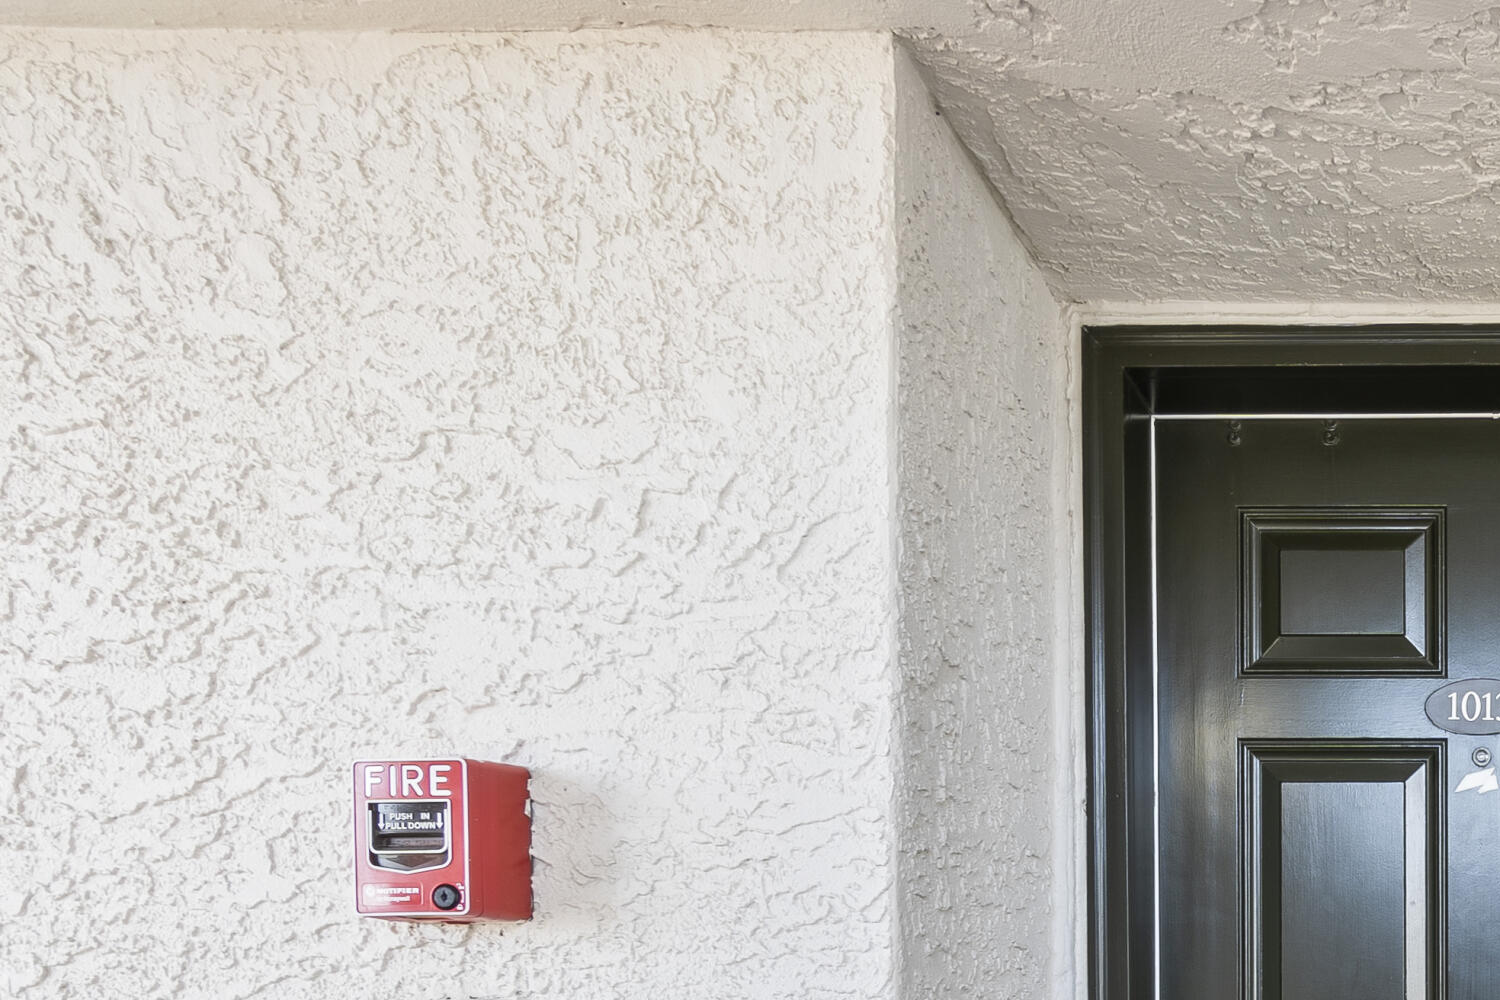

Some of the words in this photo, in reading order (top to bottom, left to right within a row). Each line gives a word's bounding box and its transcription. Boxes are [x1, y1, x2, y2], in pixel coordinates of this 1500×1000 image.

[364, 764, 452, 797] FIRE
[389, 812, 413, 820] PUSH
[420, 812, 431, 820] IN
[385, 821, 408, 830] PULL
[408, 821, 436, 830] DOWN
